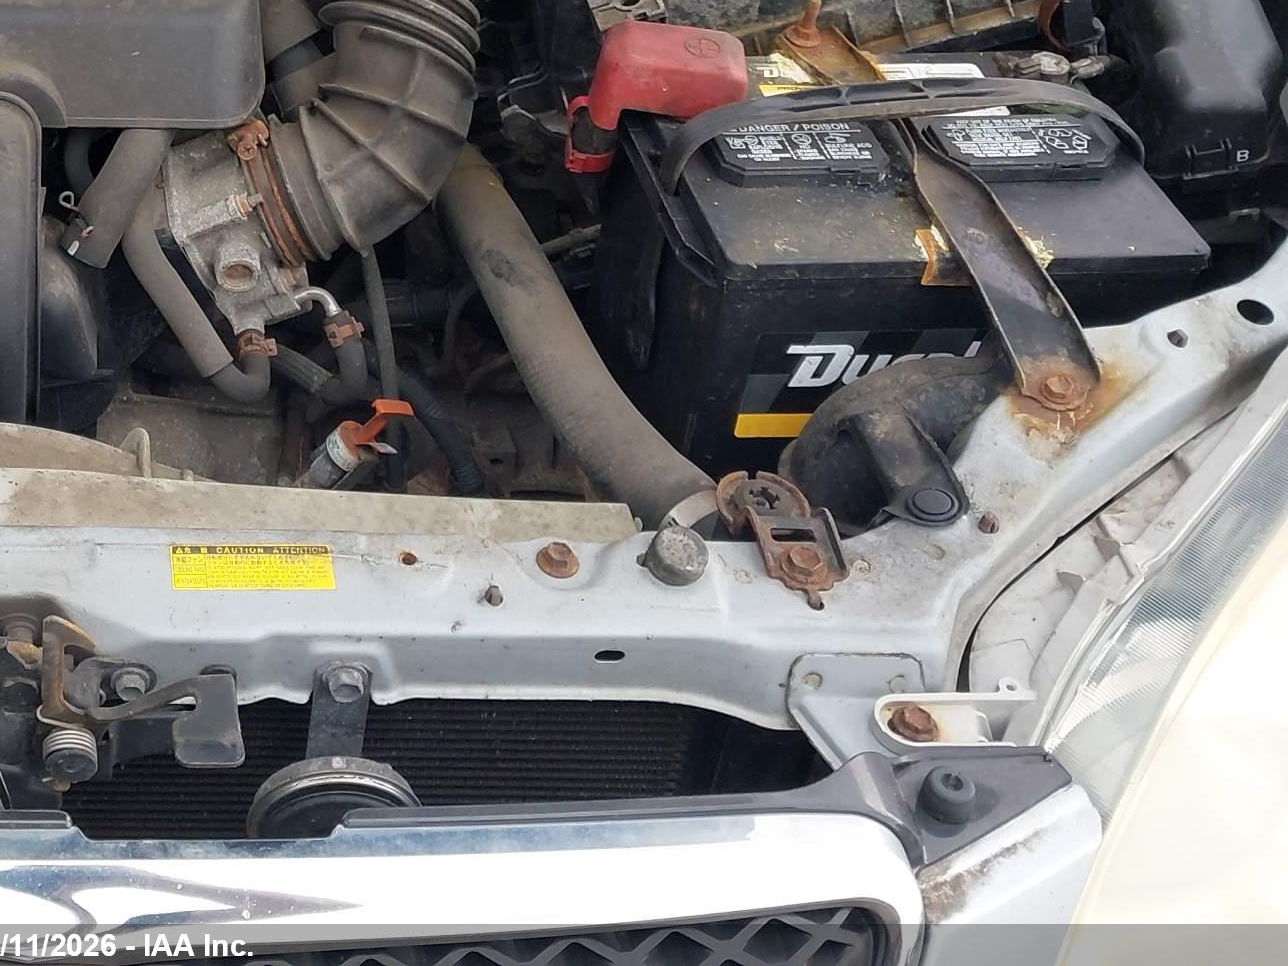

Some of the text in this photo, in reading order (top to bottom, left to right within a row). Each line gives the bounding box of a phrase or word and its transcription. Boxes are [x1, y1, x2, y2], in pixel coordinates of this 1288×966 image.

[738, 123, 790, 132] DANGER
[803, 122, 850, 131] POISON
[1237, 150, 1249, 162] B
[215, 546, 264, 554] CAUTION
[272, 546, 325, 554] ATTENTION
